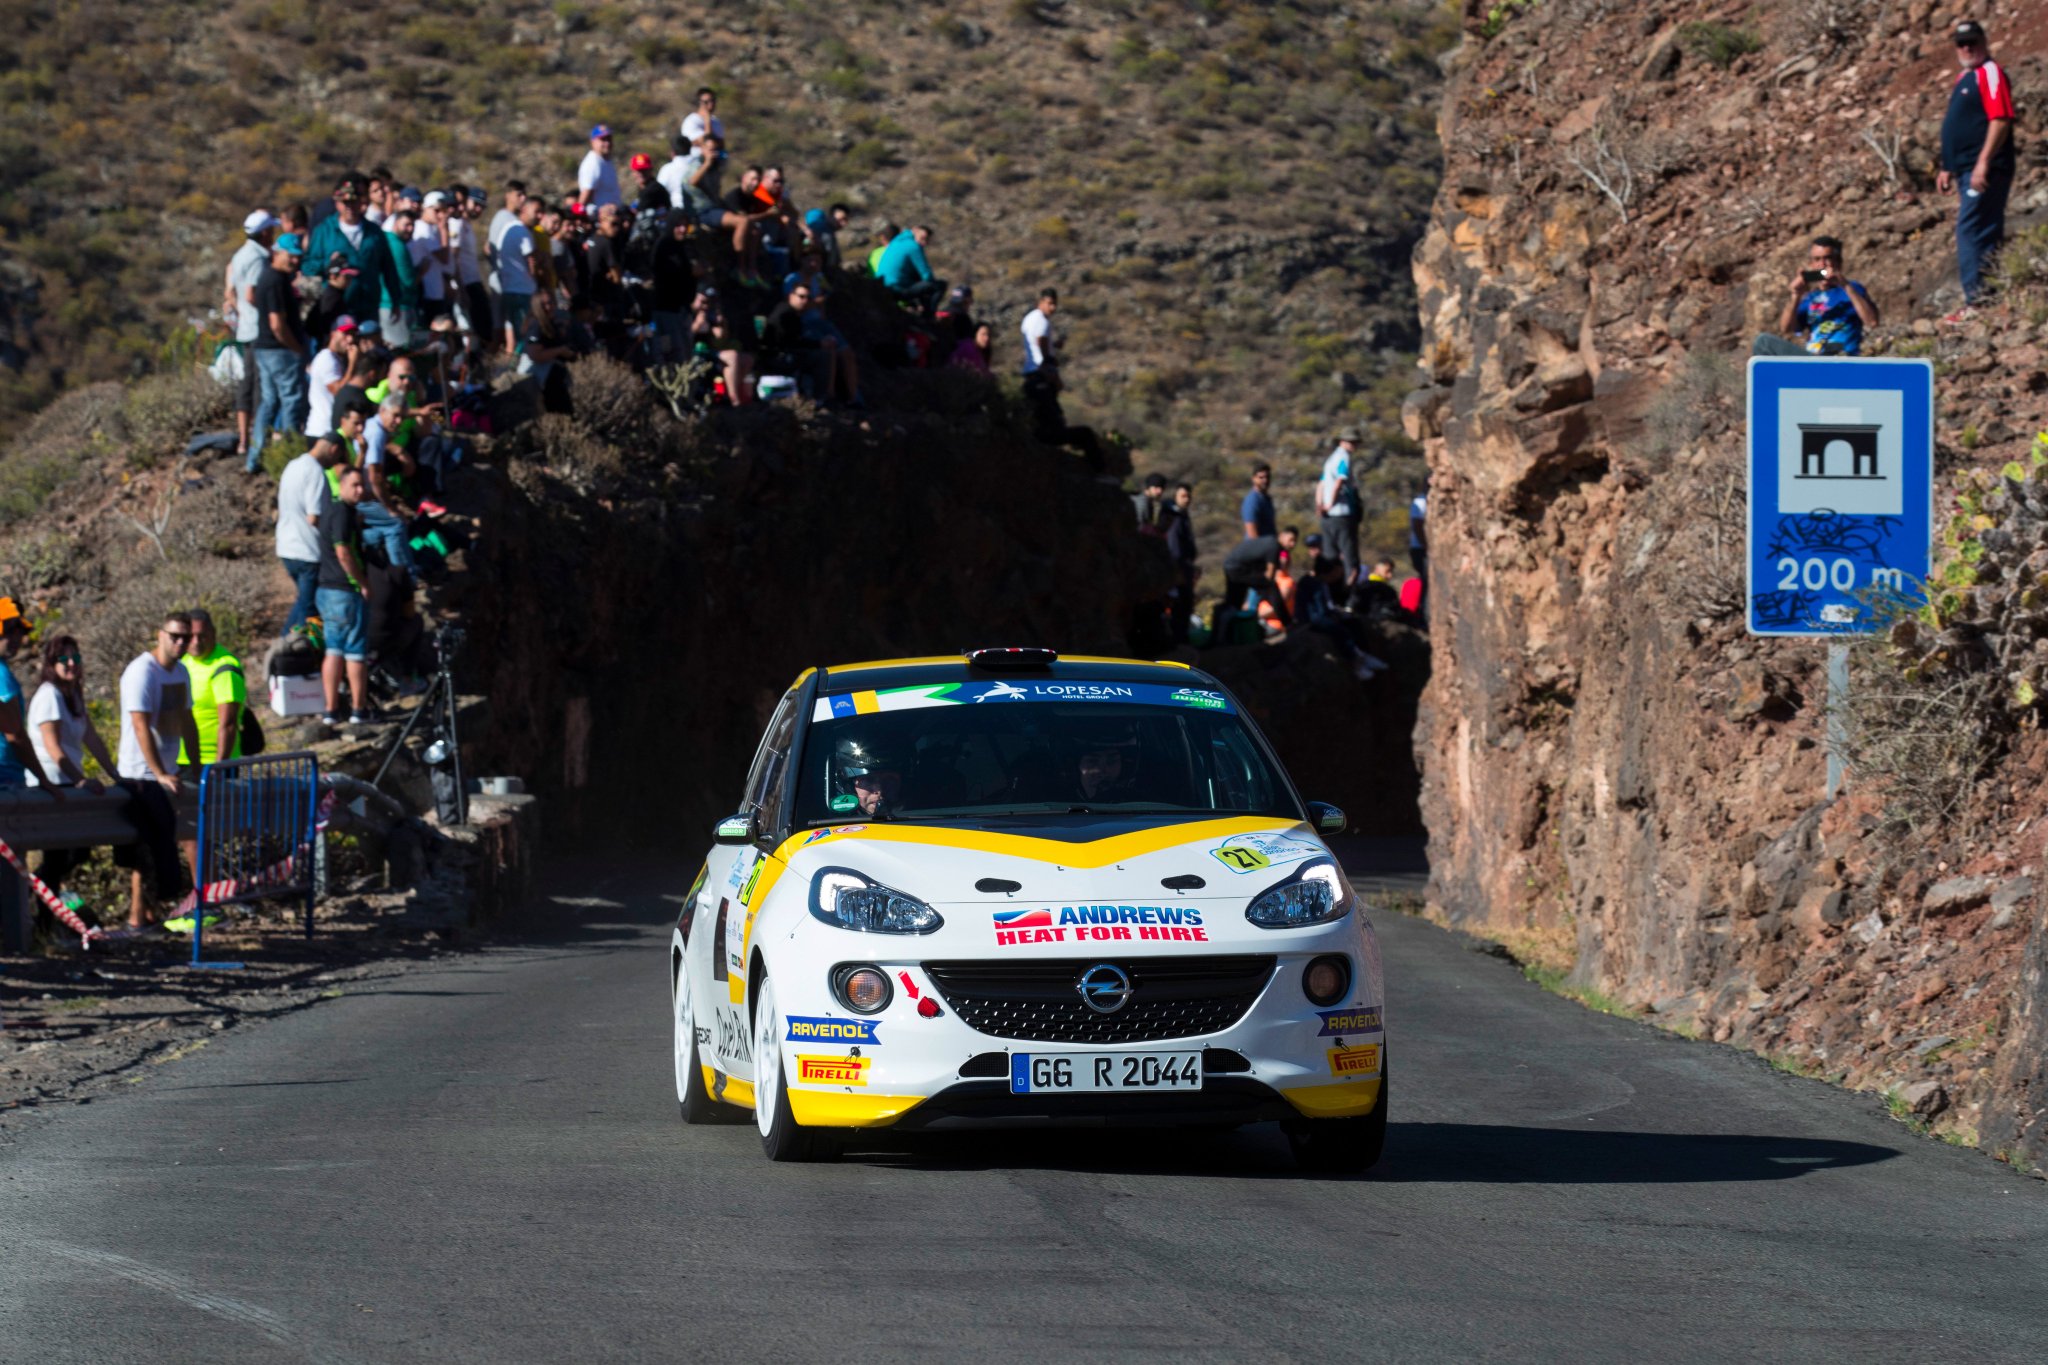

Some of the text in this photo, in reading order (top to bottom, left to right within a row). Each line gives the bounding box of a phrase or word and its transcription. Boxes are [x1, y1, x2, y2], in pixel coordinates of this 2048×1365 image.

[1777, 557, 1903, 592] 200 m
[1034, 685, 1133, 697] LOPESAN
[1174, 694, 1222, 706] JUNIOR
[1222, 847, 1263, 869] 27
[1059, 905, 1203, 926] ANDREWS
[996, 926, 1209, 946] HEAT FOR HIRE
[792, 1022, 869, 1038] RAVENOL
[802, 1060, 863, 1081] PIRELLI
[1333, 1048, 1377, 1072] PIRELLI
[1032, 1056, 1199, 1088] GG R 2044
